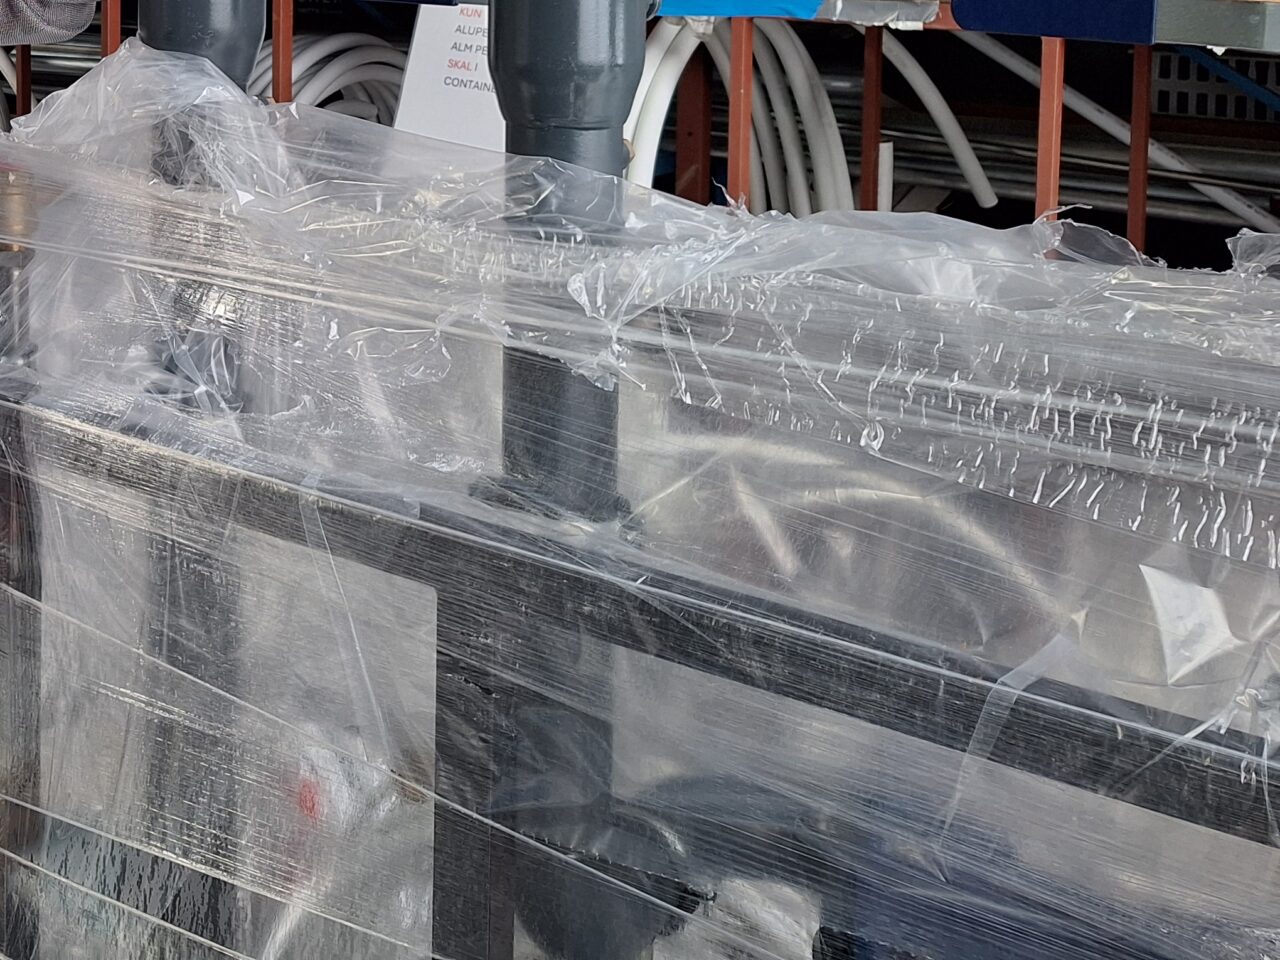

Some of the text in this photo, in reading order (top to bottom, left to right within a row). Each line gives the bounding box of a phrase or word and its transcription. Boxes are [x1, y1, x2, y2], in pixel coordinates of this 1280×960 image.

[459, 7, 482, 19] KUN
[450, 42, 473, 54] ALM
[447, 58, 472, 72] SKAL
